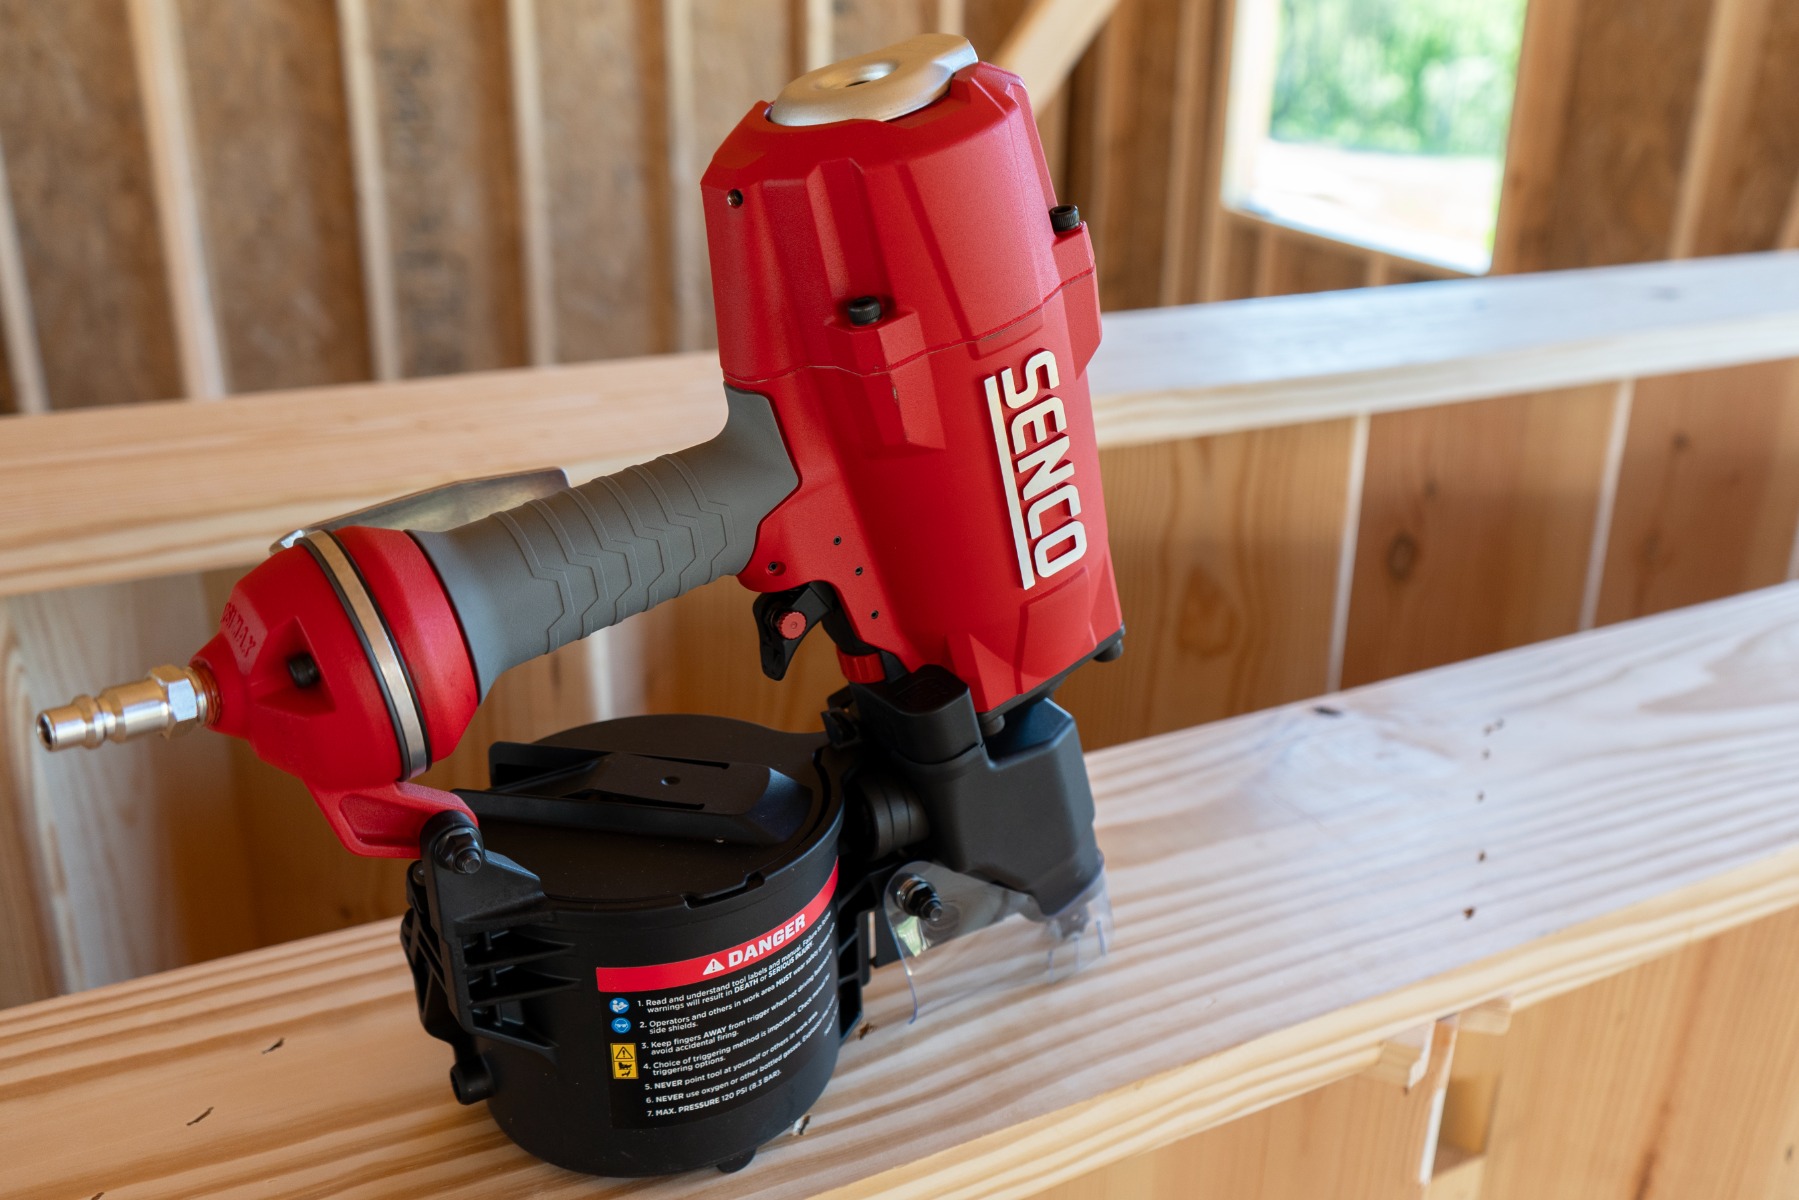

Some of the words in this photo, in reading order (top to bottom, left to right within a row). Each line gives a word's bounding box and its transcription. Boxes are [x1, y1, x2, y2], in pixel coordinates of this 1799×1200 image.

[1001, 350, 1087, 578] SENCO
[728, 914, 805, 967] DANGER
[646, 998, 667, 1006] Read
[669, 995, 684, 1003] and
[686, 982, 730, 1000] understand
[732, 976, 746, 987] tool
[748, 967, 767, 981] labels
[768, 959, 780, 970] and
[647, 1003, 684, 1013] warnings
[686, 999, 700, 1007] will
[702, 992, 723, 1004] result
[734, 978, 759, 993] DEATH
[760, 974, 767, 982] or
[768, 956, 795, 978] SERIOUS
[649, 1017, 690, 1028] Operators
[691, 1011, 706, 1020] and
[708, 1004, 732, 1016] others
[734, 1000, 741, 1008] in
[742, 992, 760, 1004] work
[761, 984, 775, 996] area
[775, 972, 792, 987] MUST
[651, 1041, 672, 1049] Keep
[673, 1034, 701, 1045] fingers
[703, 1026, 727, 1038] AWAY
[728, 1020, 746, 1030] from
[747, 1008, 770, 1023] trigger
[771, 997, 788, 1010] when
[787, 990, 797, 1000] not
[651, 1047, 673, 1055] avoid
[675, 1037, 716, 1051] accidental
[717, 1030, 739, 1042] firing.
[653, 1061, 681, 1069] Choice
[692, 1046, 731, 1061] triggering
[732, 1033, 759, 1050] method
[760, 1030, 767, 1038] is
[767, 1011, 798, 1034] important.
[668, 1022, 698, 1032] shields.
[653, 1065, 693, 1076] triggering
[694, 1056, 726, 1069] options.
[654, 1079, 683, 1089] NEVER
[684, 1074, 705, 1085] point
[707, 1070, 722, 1079] tool
[723, 1066, 732, 1074] at
[733, 1052, 761, 1071] yourself
[762, 1049, 770, 1057] or
[770, 1037, 789, 1053] others
[655, 1093, 684, 1103] NEVER
[685, 1090, 700, 1098] use
[701, 1081, 729, 1095] oxygen
[740, 1068, 758, 1081] other
[759, 1053, 783, 1072] bottled
[655, 1108, 677, 1116] MAX.
[678, 1097, 720, 1113] PRESSURE
[721, 1092, 735, 1101] 120
[736, 1086, 748, 1096] PSI
[748, 1079, 763, 1091] (8.3
[763, 1069, 782, 1084] BAR).
